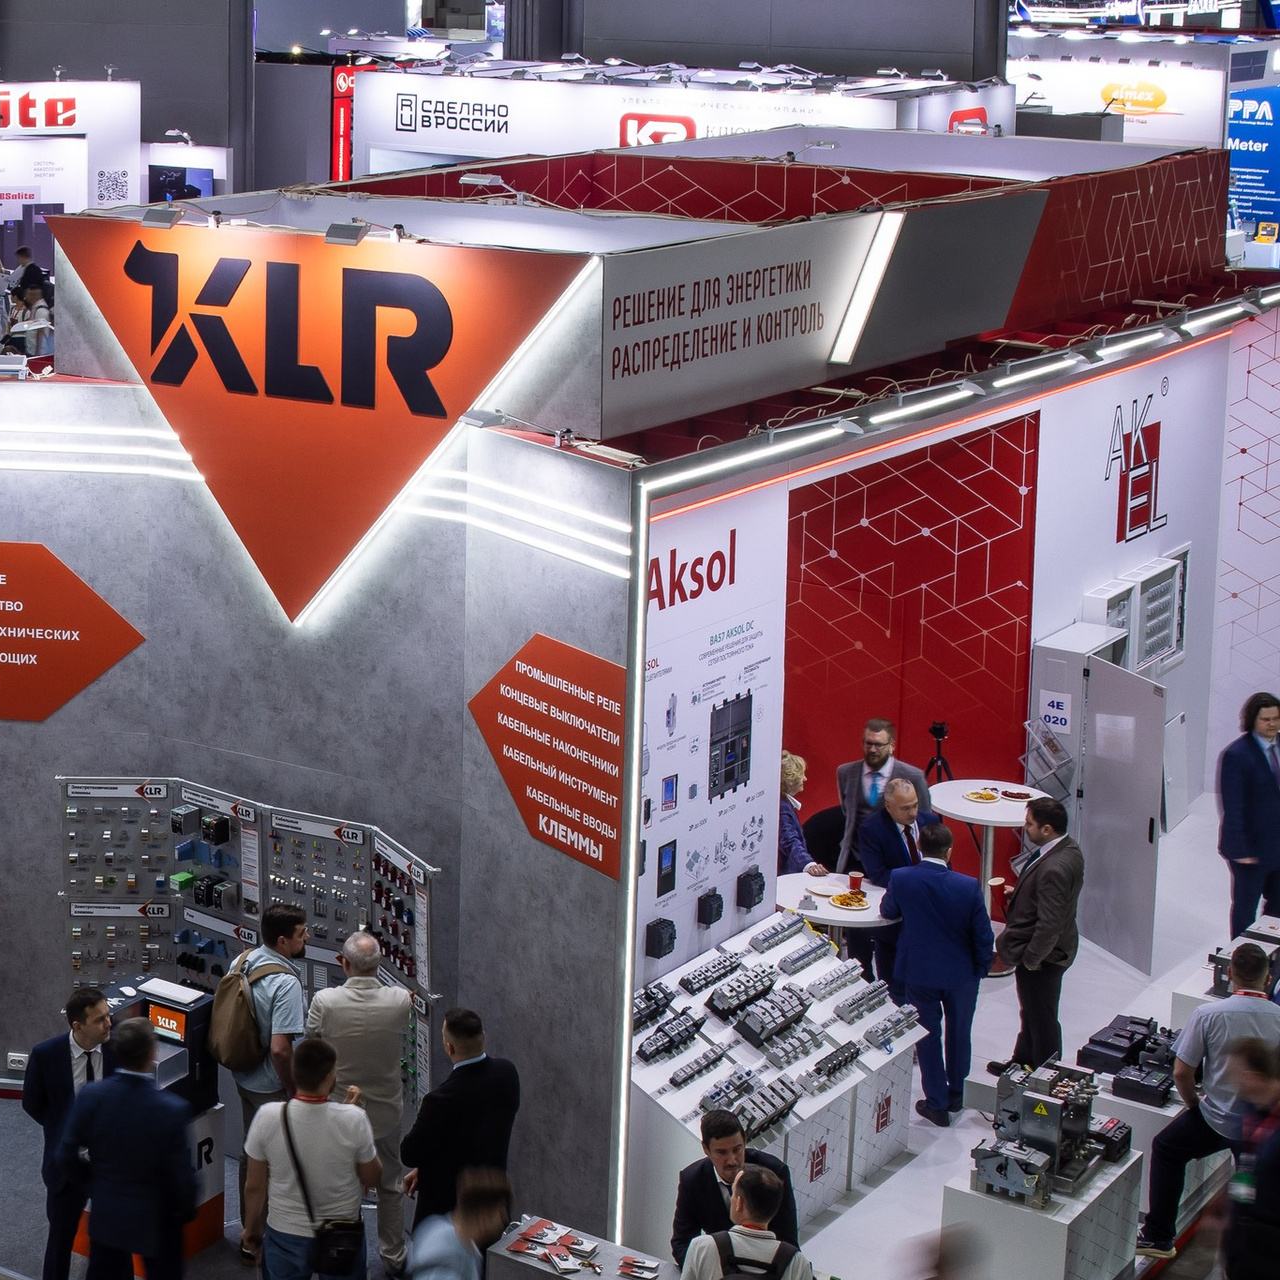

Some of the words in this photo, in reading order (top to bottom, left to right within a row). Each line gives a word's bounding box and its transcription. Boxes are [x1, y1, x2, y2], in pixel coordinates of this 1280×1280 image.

[421, 100, 509, 117] СДЕЛАНО
[1228, 137, 1269, 152] Meter
[612, 284, 686, 331] РЕШЕНИЕ
[690, 277, 720, 319] ДЛЯ
[726, 259, 812, 306] ЭНЕРГЕТИКИ
[612, 320, 737, 380] РАСПРЕДЕЛЕНИЕ
[743, 317, 751, 348] И
[756, 301, 824, 345] КОНТРОЛЬ
[647, 528, 737, 616] Aksol
[726, 623, 745, 640] AKSOL
[746, 619, 753, 631] DC
[515, 660, 595, 704] ПРОМЫШЛЕННЫЕ
[596, 697, 621, 716] РЕЛЕ
[500, 683, 548, 715] КОНЦЕВЫЕ
[550, 706, 620, 747] ВЫКЛЮЧАТЕЛИ
[1046, 700, 1064, 711] 4E
[1044, 714, 1068, 727] 020
[497, 712, 551, 745] КАБЕЛЬНЫЕ
[552, 737, 619, 778] НАКОНЕЧНИКИ
[503, 744, 557, 780] КАБЕЛЬНЫЙ
[558, 771, 618, 808] ИНСТРУМЕНТ
[144, 787, 162, 796] KLR
[526, 785, 581, 821] КАБЕЛЬНЫЕ
[583, 812, 617, 840] ВВОДЫ
[341, 828, 359, 841] KLR
[538, 814, 603, 862] КЛЕММЫ
[146, 906, 165, 916] KLR
[240, 929, 254, 942] KLR
[156, 1015, 178, 1031] KLR
